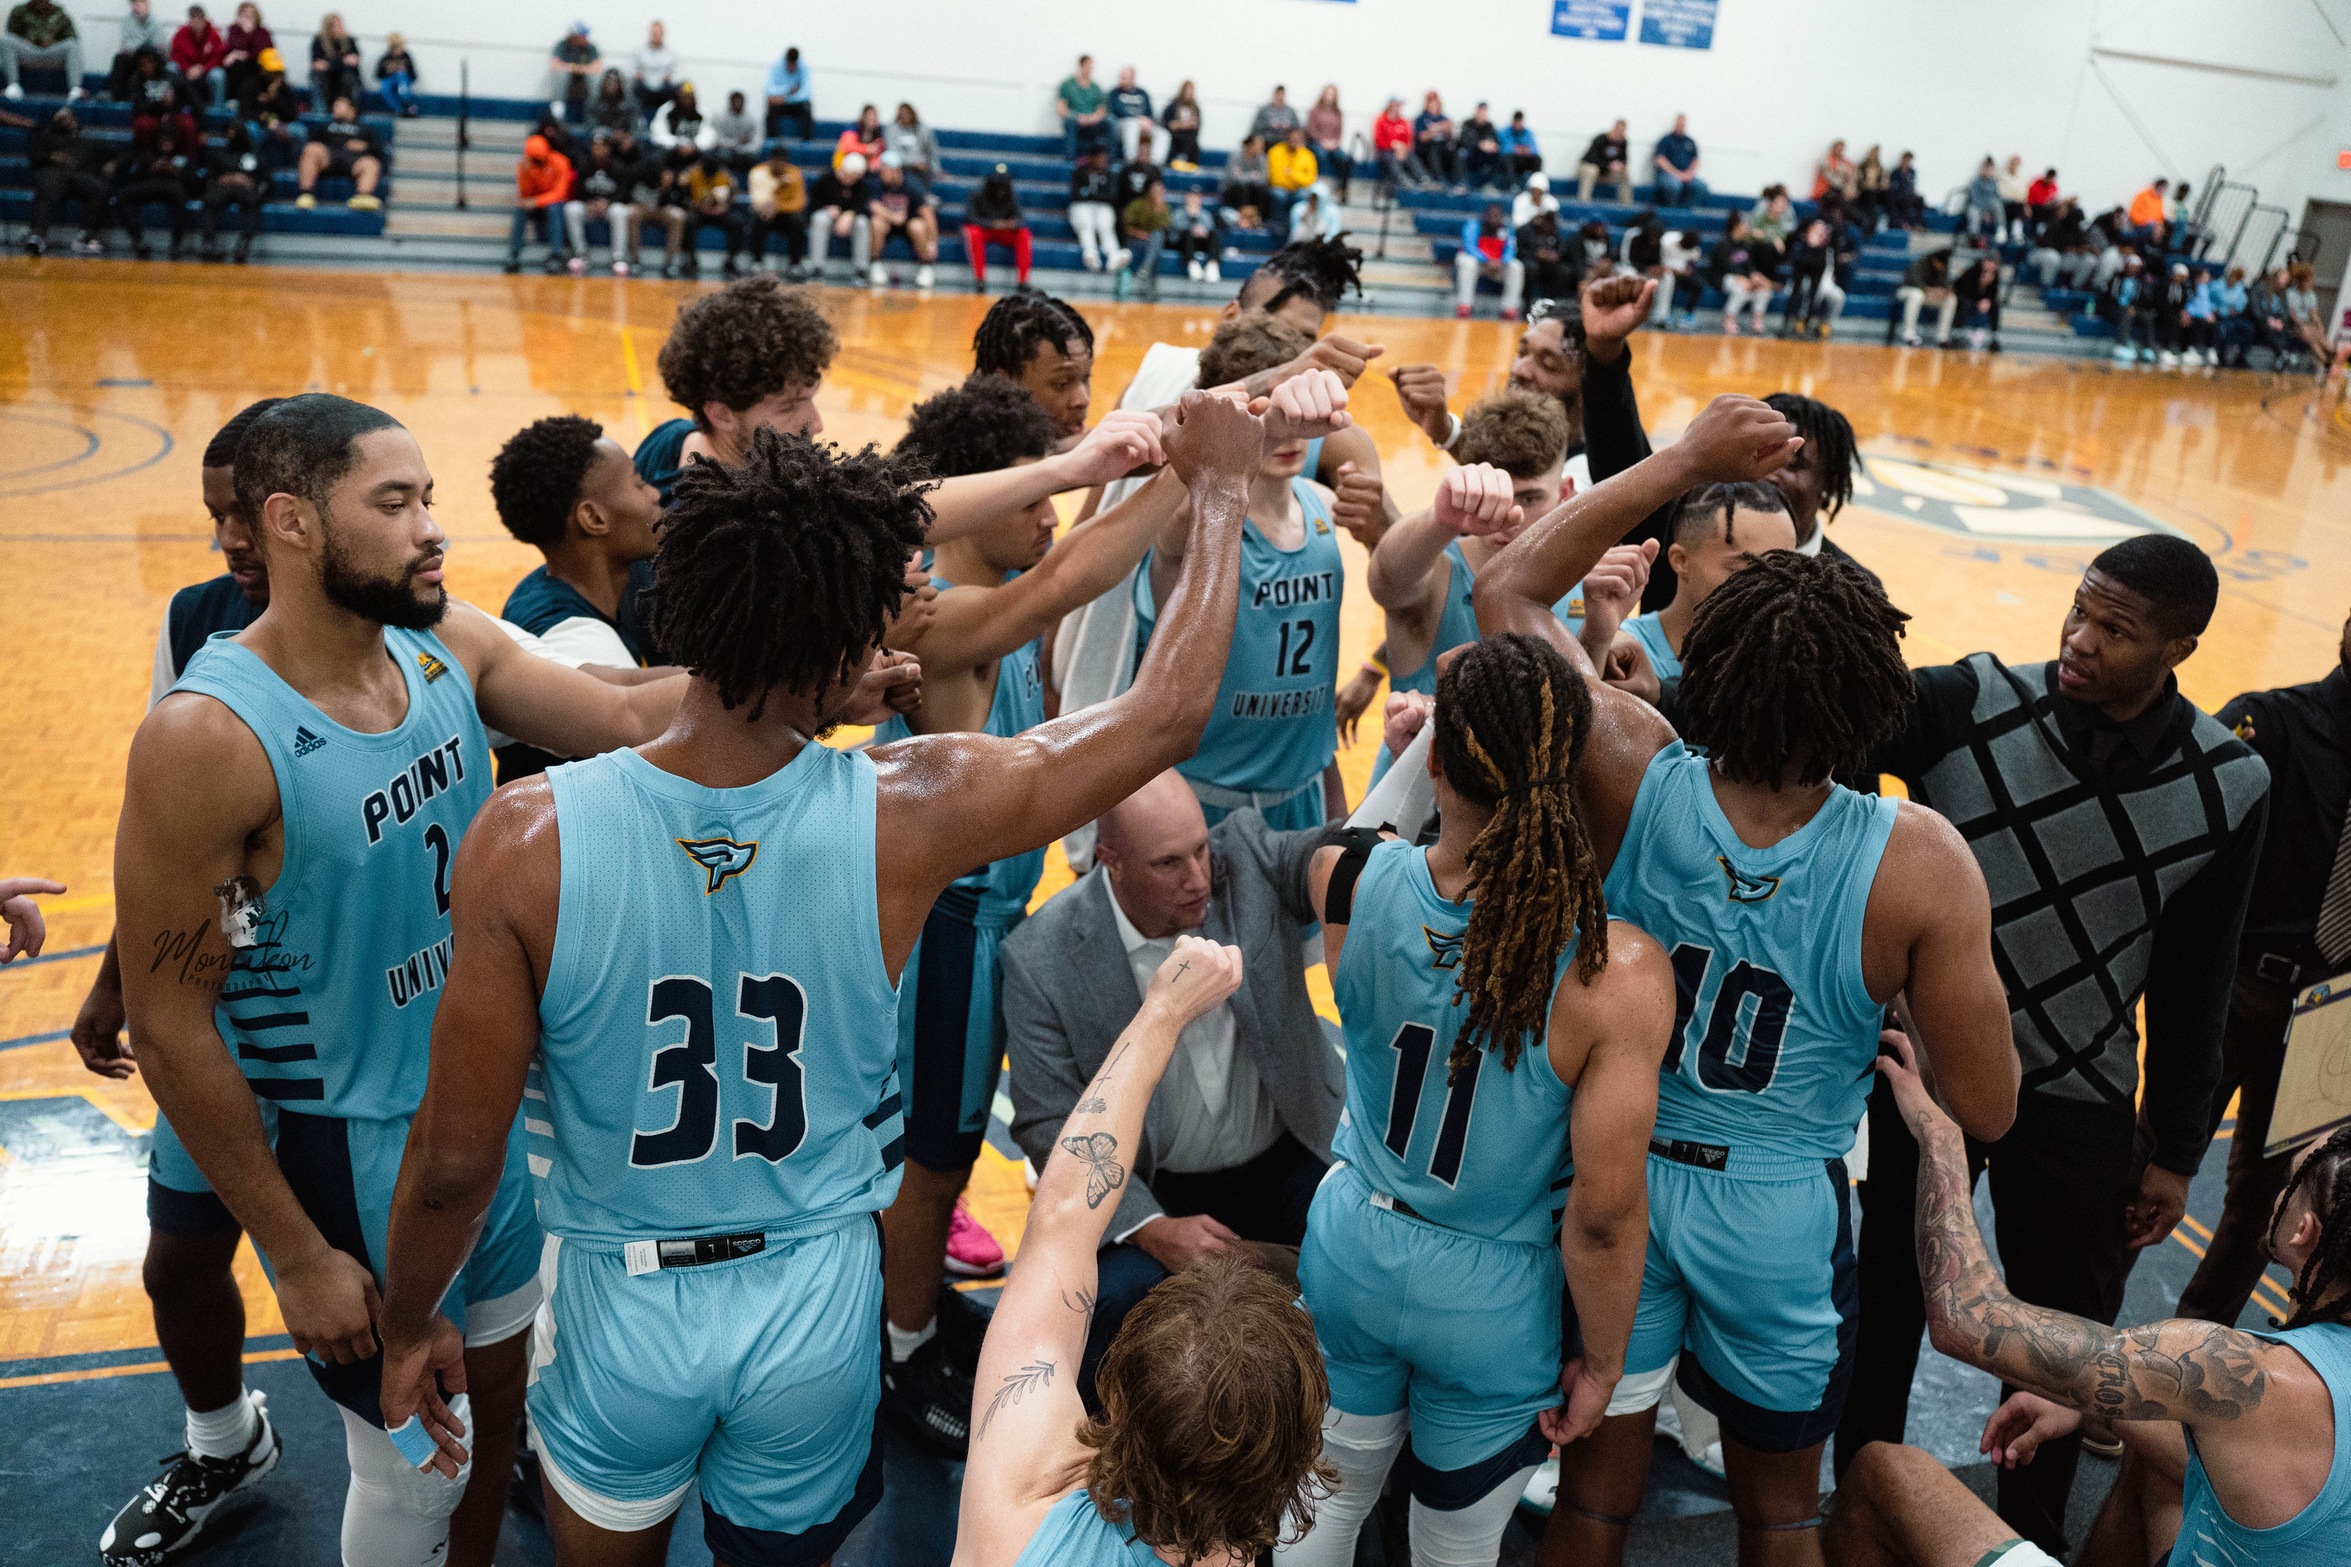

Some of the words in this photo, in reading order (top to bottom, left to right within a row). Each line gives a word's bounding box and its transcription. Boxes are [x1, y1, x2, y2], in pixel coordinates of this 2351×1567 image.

[1252, 571, 1333, 610] POINT
[1275, 619, 1315, 678] 12
[294, 737, 327, 758] adidas
[362, 733, 466, 847] POINT
[423, 822, 450, 919] 2
[628, 971, 809, 1170] 33
[1662, 941, 1797, 1095] 10
[1385, 1021, 1485, 1190] 11
